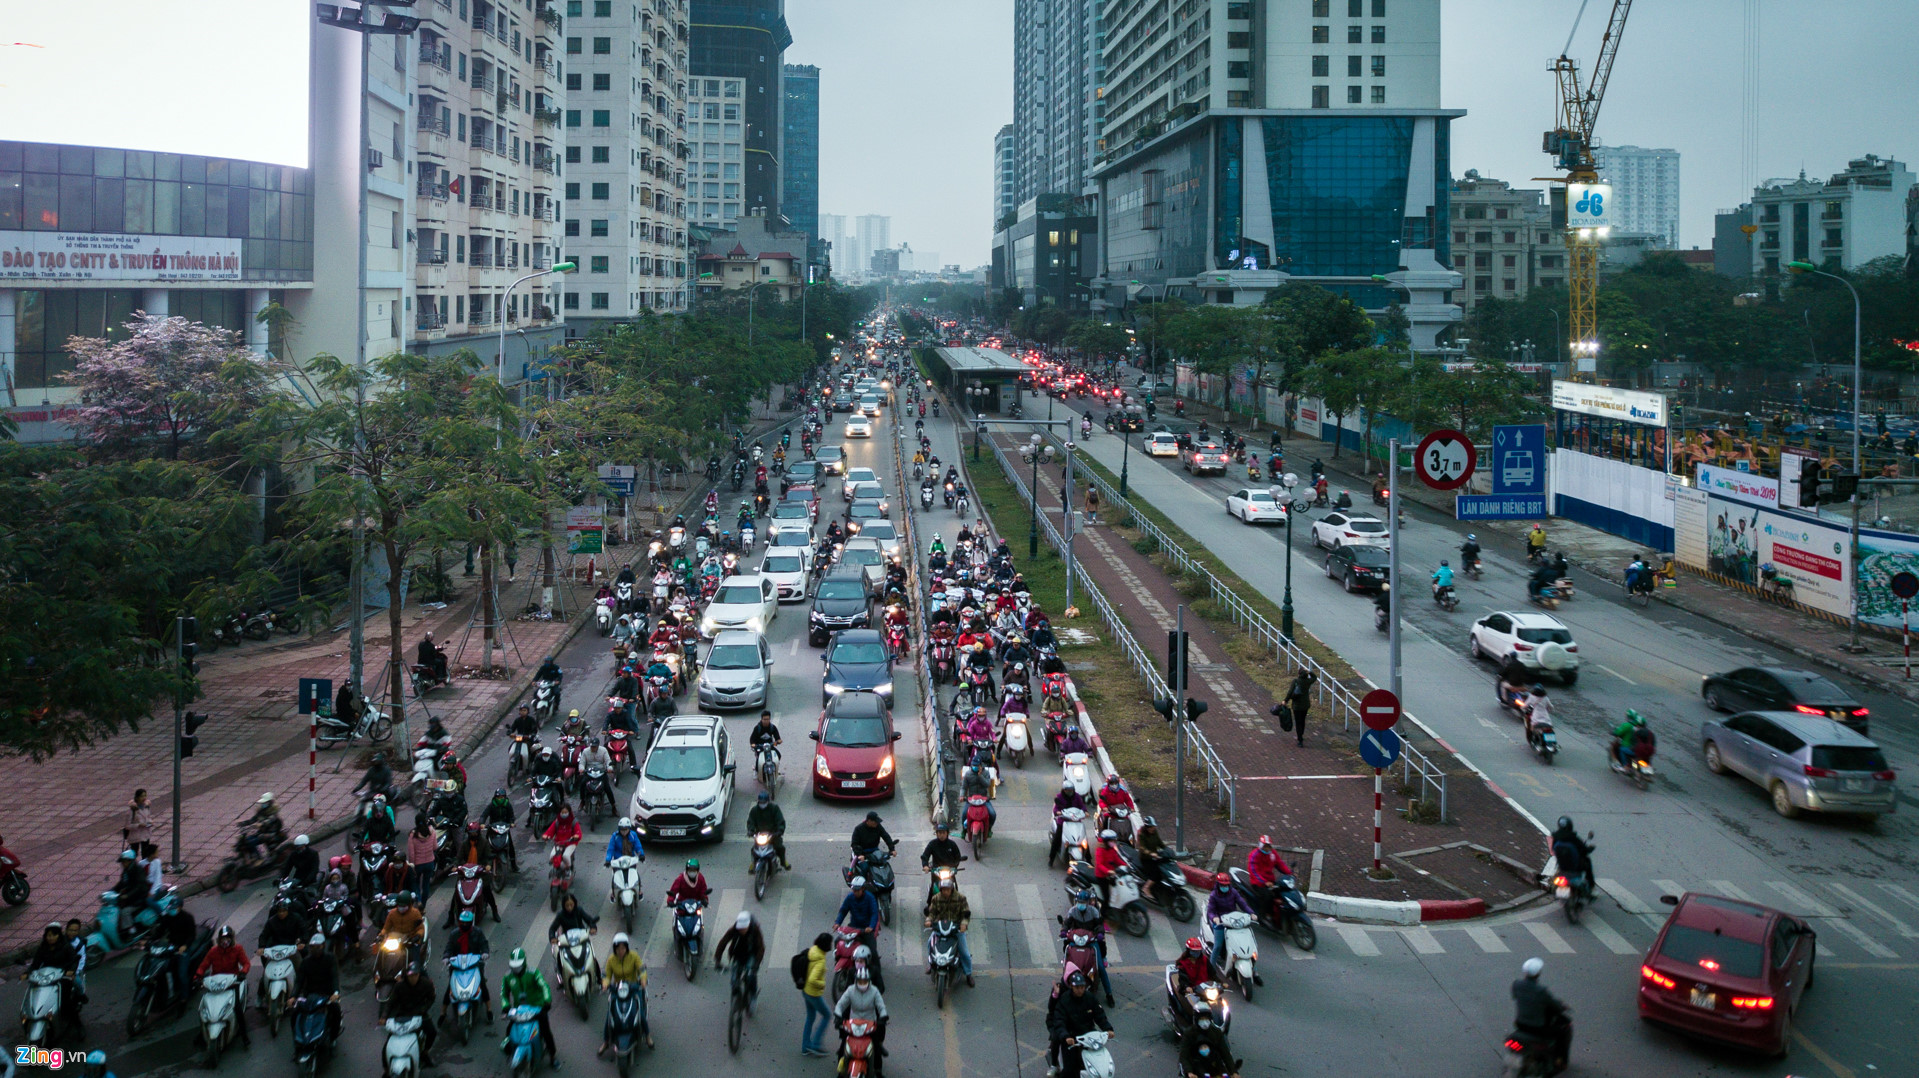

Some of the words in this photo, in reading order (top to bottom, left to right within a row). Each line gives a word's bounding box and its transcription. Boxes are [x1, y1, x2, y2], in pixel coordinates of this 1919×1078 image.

[2, 246, 34, 268] ĐÀO
[38, 252, 66, 271] TẠO
[70, 252, 106, 269] CNTT
[109, 253, 119, 269] &
[121, 248, 168, 270] TRUYỀN
[170, 250, 207, 270] THÔNG
[208, 251, 222, 270] HÀ
[223, 251, 239, 273] NỘI
[1430, 450, 1449, 474] 3,7
[1453, 461, 1461, 471] m
[1760, 486, 1776, 500] 2019
[1462, 499, 1477, 515] LÀN
[1480, 499, 1500, 515] DÀNH
[1502, 499, 1525, 515] RIÊNG
[1528, 502, 1542, 514] BRT
[1774, 545, 1786, 554] CÔNG
[1786, 548, 1804, 561] TRƯỜNG
[1805, 555, 1818, 565] ĐANG
[1826, 559, 1839, 570] CÔNG
